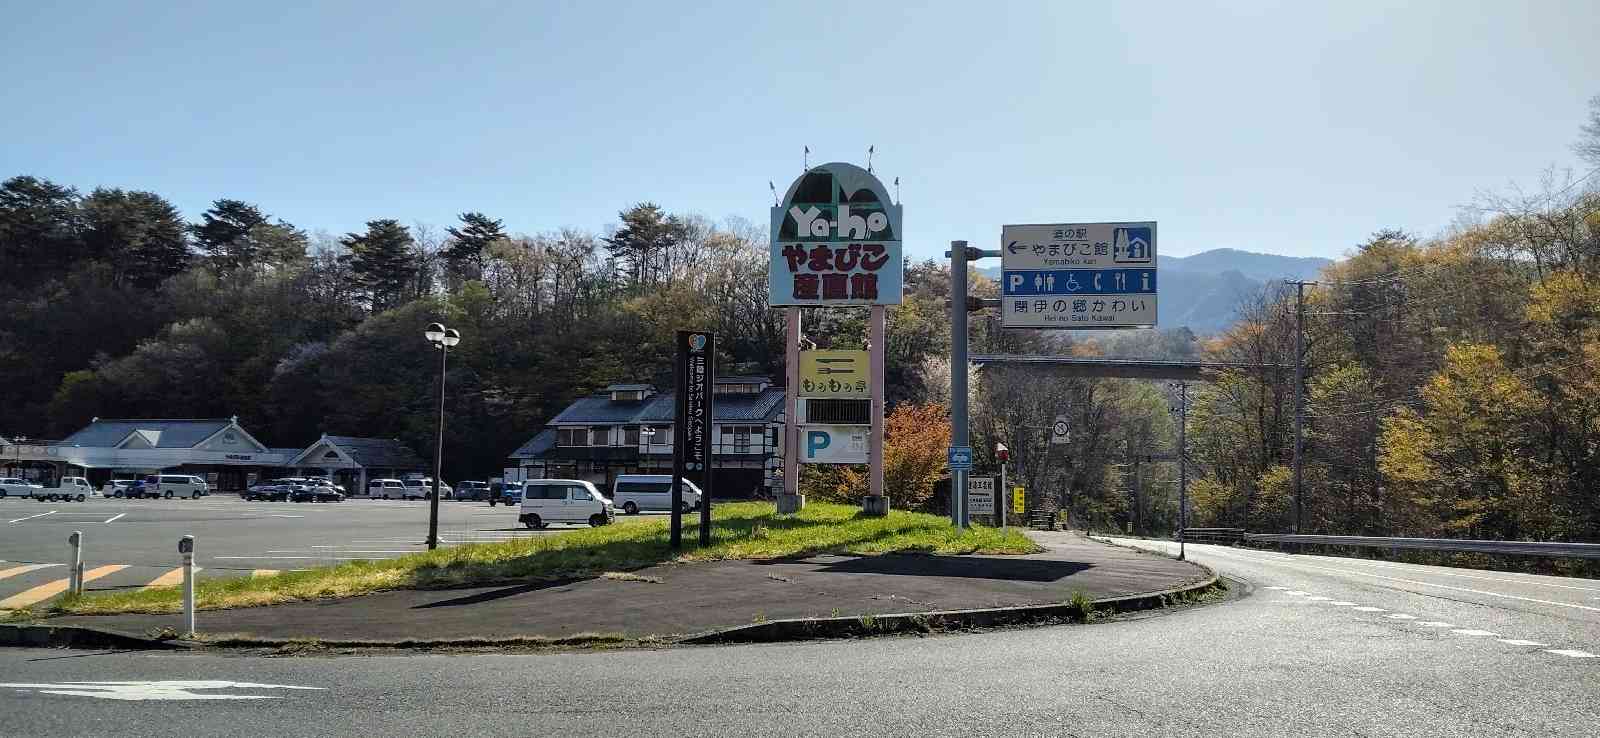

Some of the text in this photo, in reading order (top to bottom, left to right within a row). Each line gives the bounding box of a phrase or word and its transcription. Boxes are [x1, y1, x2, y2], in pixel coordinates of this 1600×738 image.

[789, 204, 888, 240] Ya-ho
[782, 243, 890, 272] やまびこ
[1032, 242, 1109, 257] やまびこ館
[792, 273, 879, 300] 産直館
[1014, 298, 1146, 313] 閉伊の郷かわい
[807, 430, 832, 459] P
